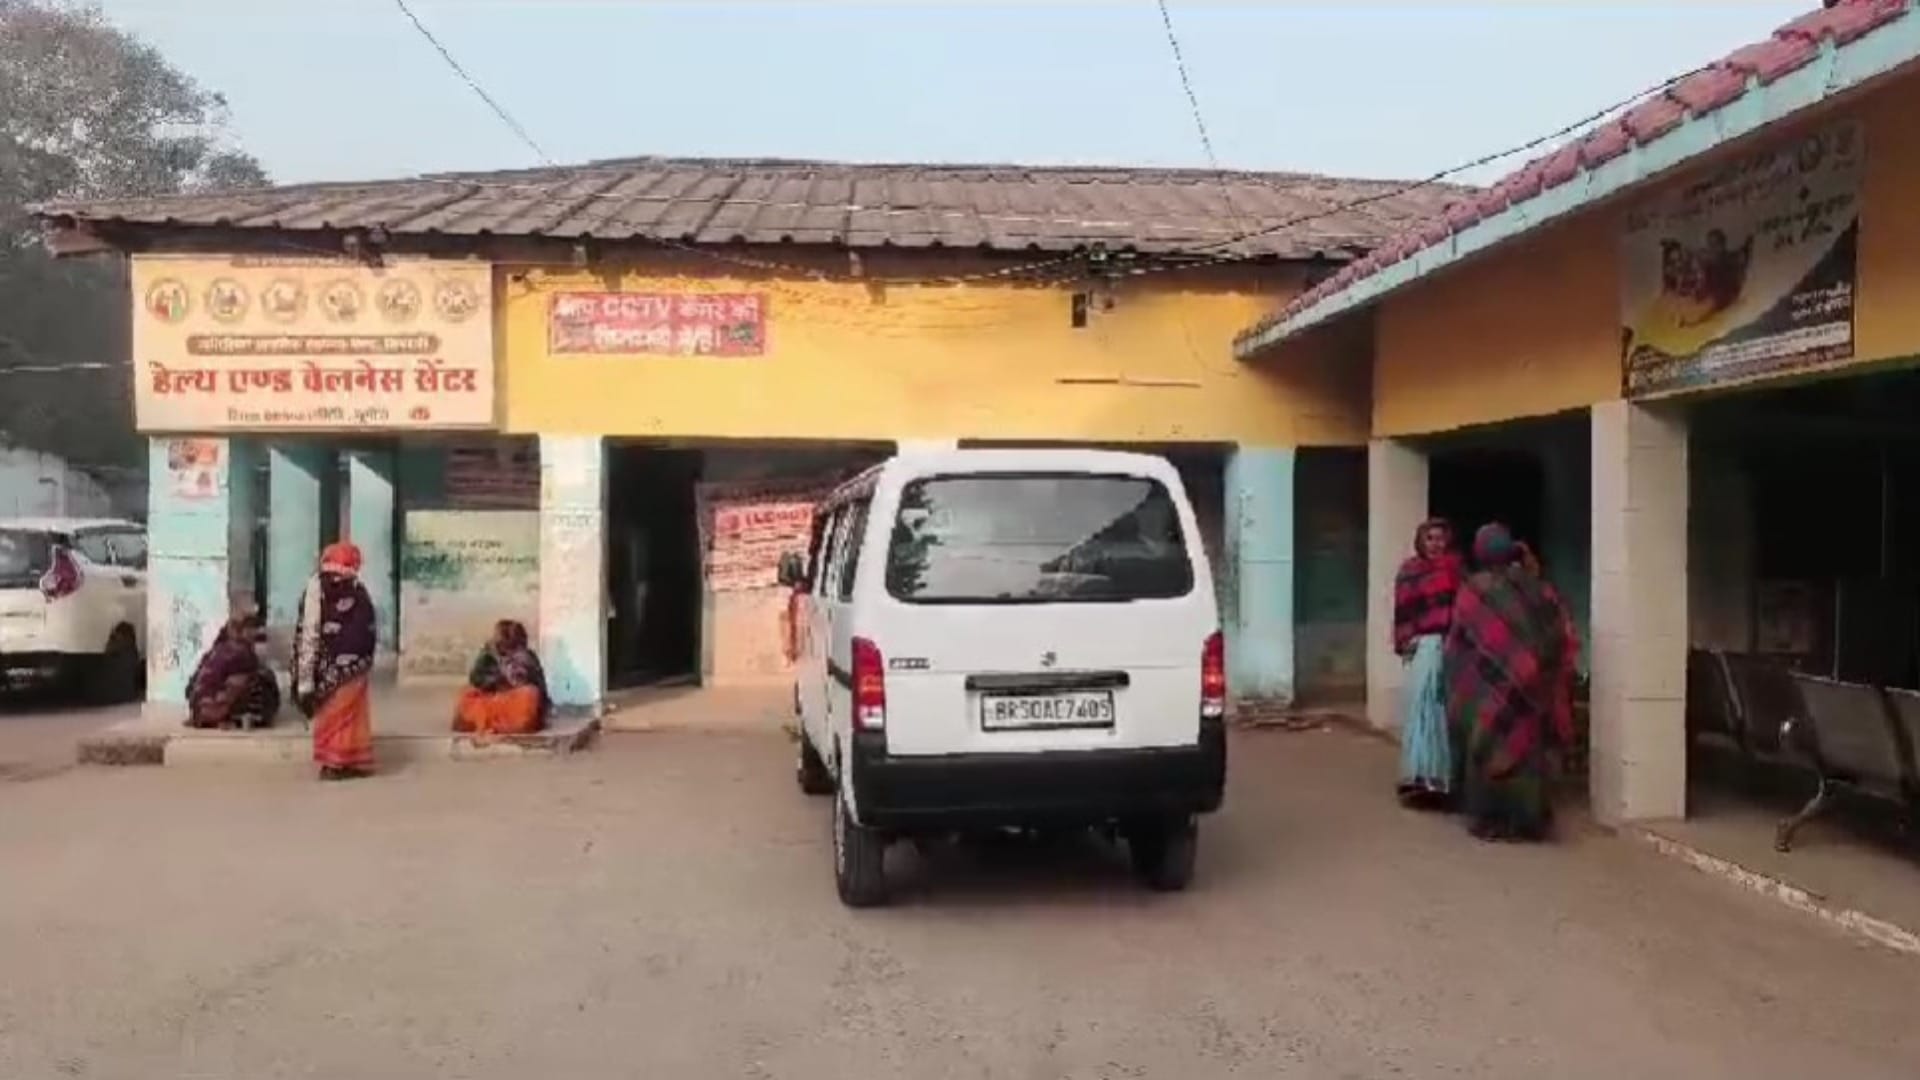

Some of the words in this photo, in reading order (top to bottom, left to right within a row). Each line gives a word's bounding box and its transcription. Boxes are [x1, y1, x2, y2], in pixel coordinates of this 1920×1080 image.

[602, 297, 672, 321] CCTV
[150, 360, 217, 393] हेल्थ
[228, 369, 293, 392] एण्ड
[302, 361, 404, 393] वेलनेस
[415, 360, 478, 392] सेंटर
